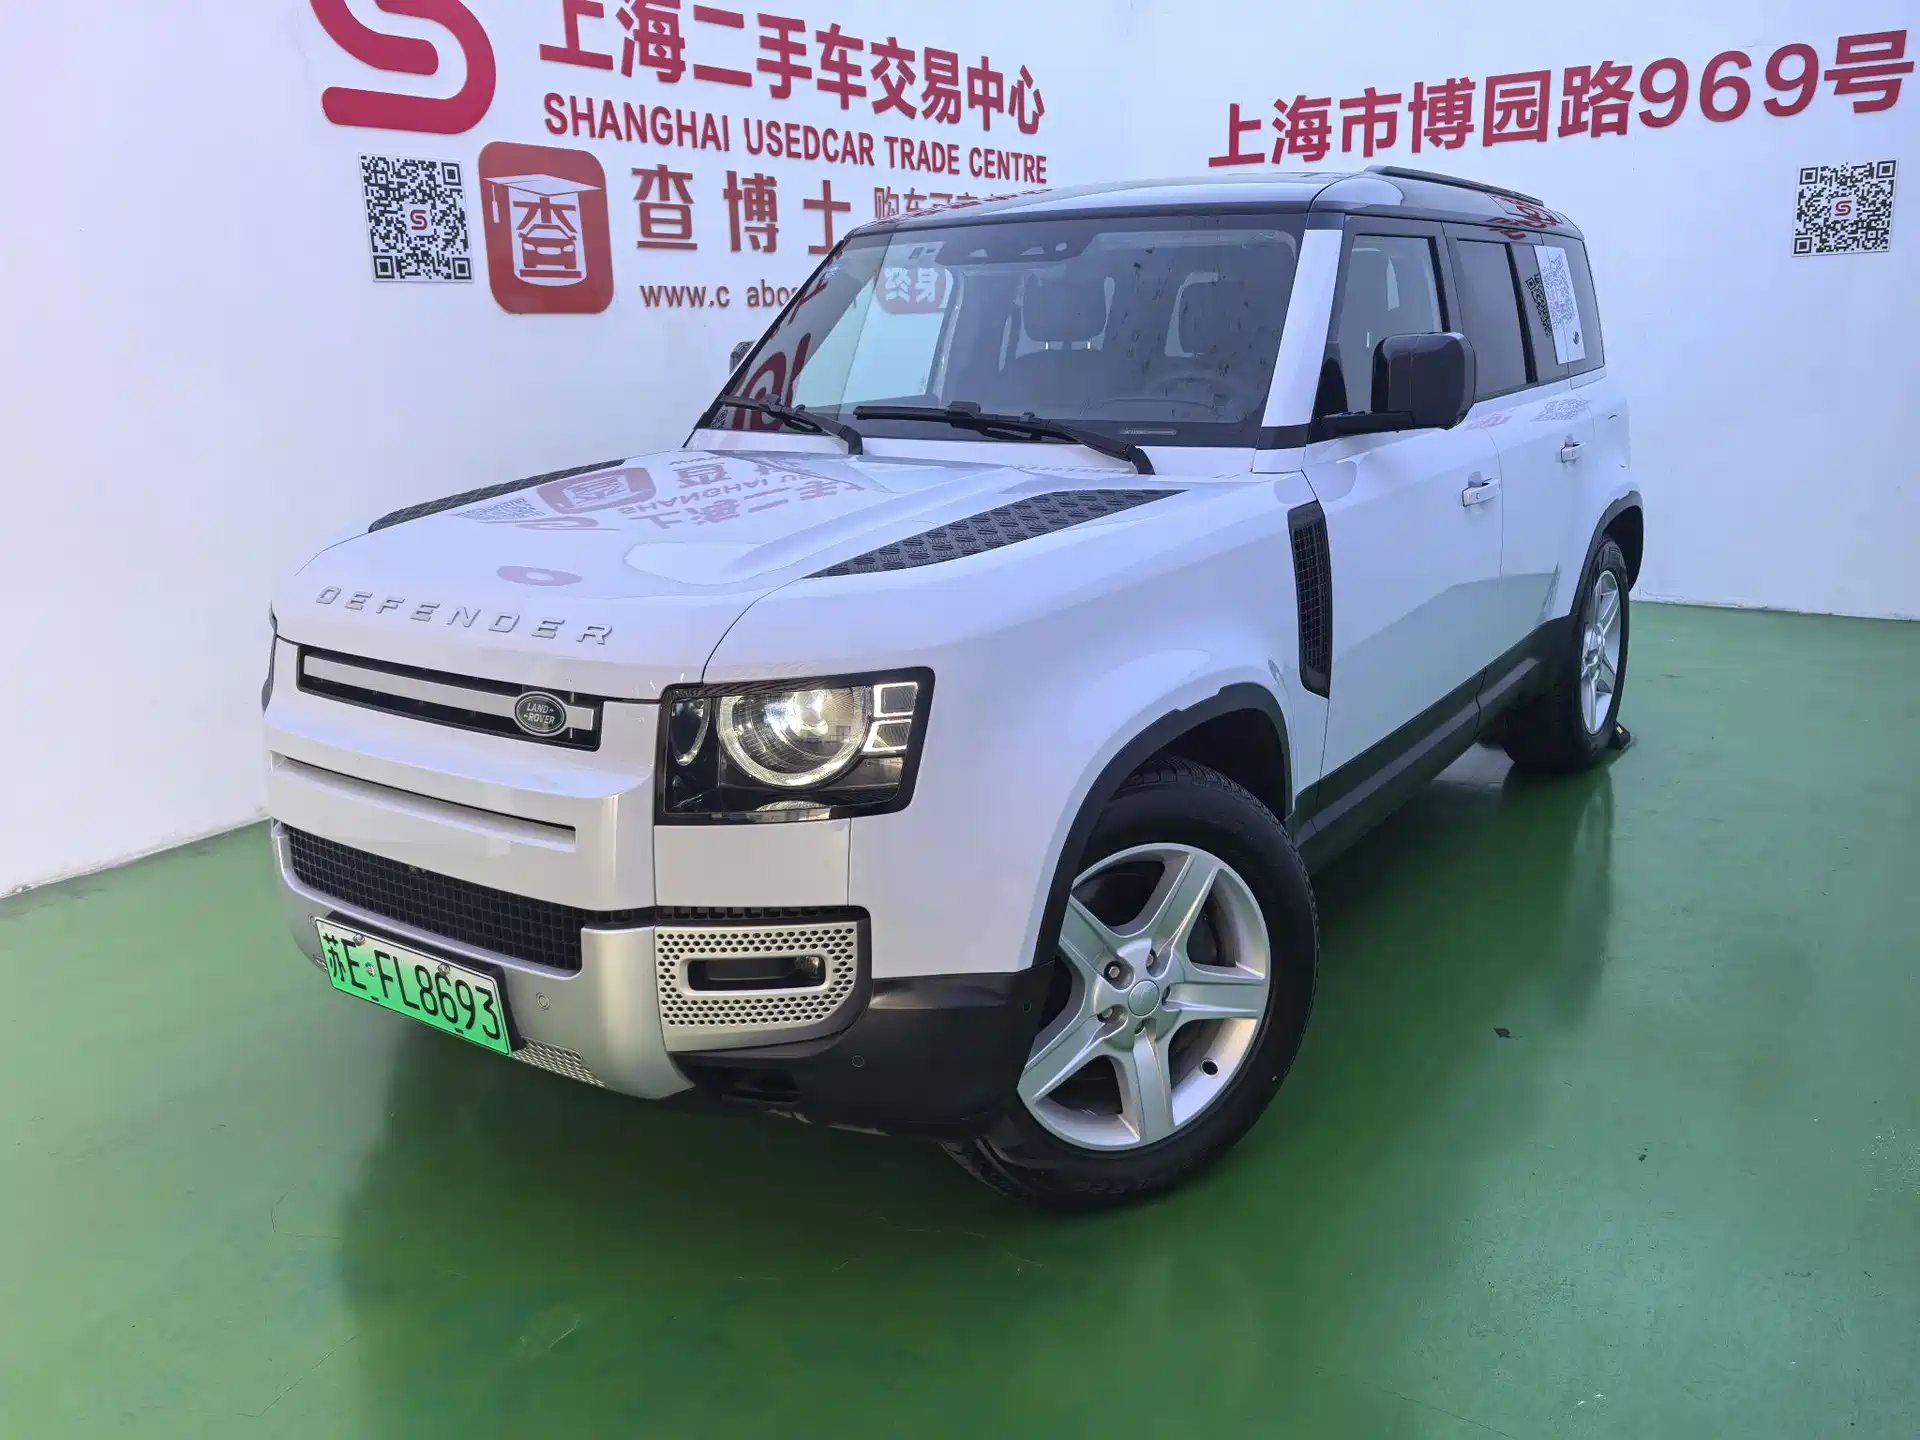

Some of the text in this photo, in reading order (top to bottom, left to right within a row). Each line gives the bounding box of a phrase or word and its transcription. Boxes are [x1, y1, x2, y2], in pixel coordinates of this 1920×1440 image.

[540, 0, 1046, 136] 上海二手车交易中心
[1208, 29, 1915, 168] 上海市博园路969号
[544, 92, 1047, 184] SHANGHAI USEDCAR TRADE CENTRE
[632, 164, 851, 254] 查博士
[747, 279, 799, 308] abo
[316, 586, 613, 646] DEFENDER
